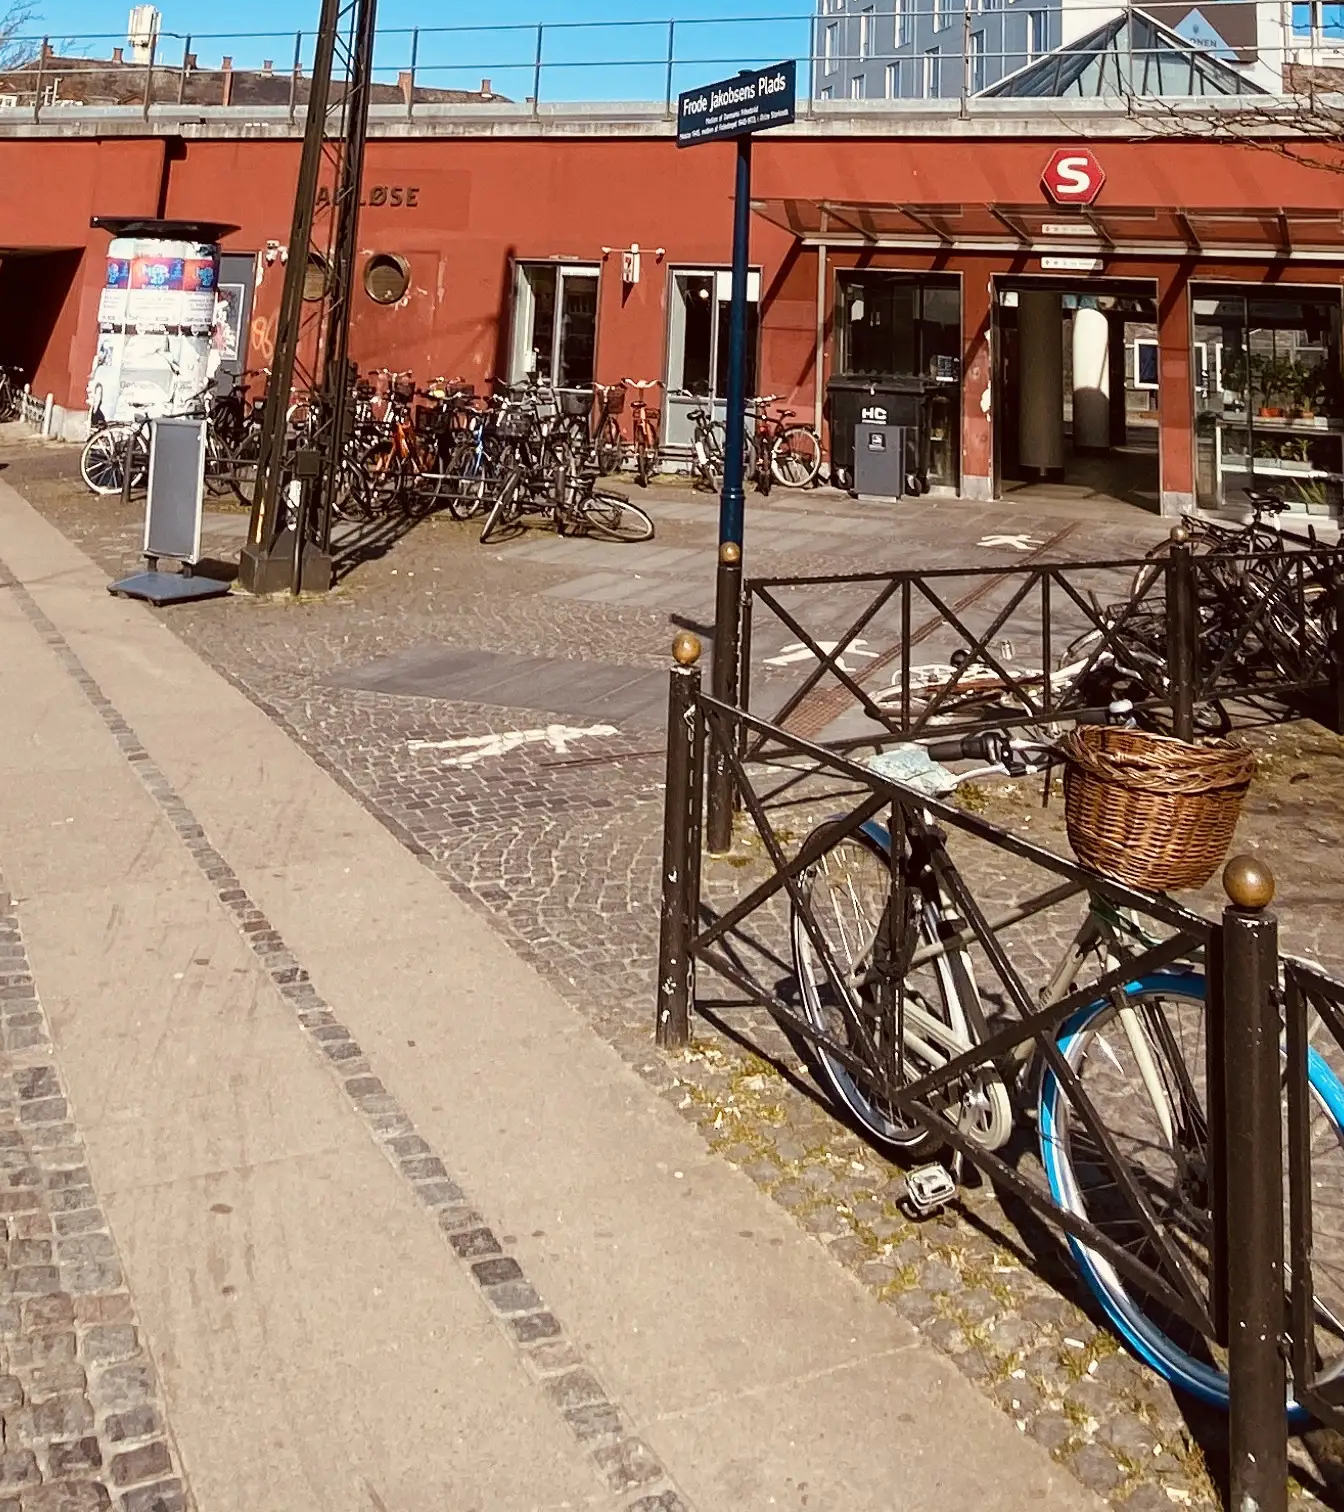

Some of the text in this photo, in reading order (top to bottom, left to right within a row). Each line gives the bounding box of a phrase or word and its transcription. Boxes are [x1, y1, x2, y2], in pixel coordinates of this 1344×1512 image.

[683, 95, 707, 116] Frode
[709, 83, 755, 112] Jakobsens
[758, 72, 786, 96] Plads
[1056, 157, 1090, 194] S
[315, 185, 420, 207] AØSE
[862, 407, 887, 420] HC
